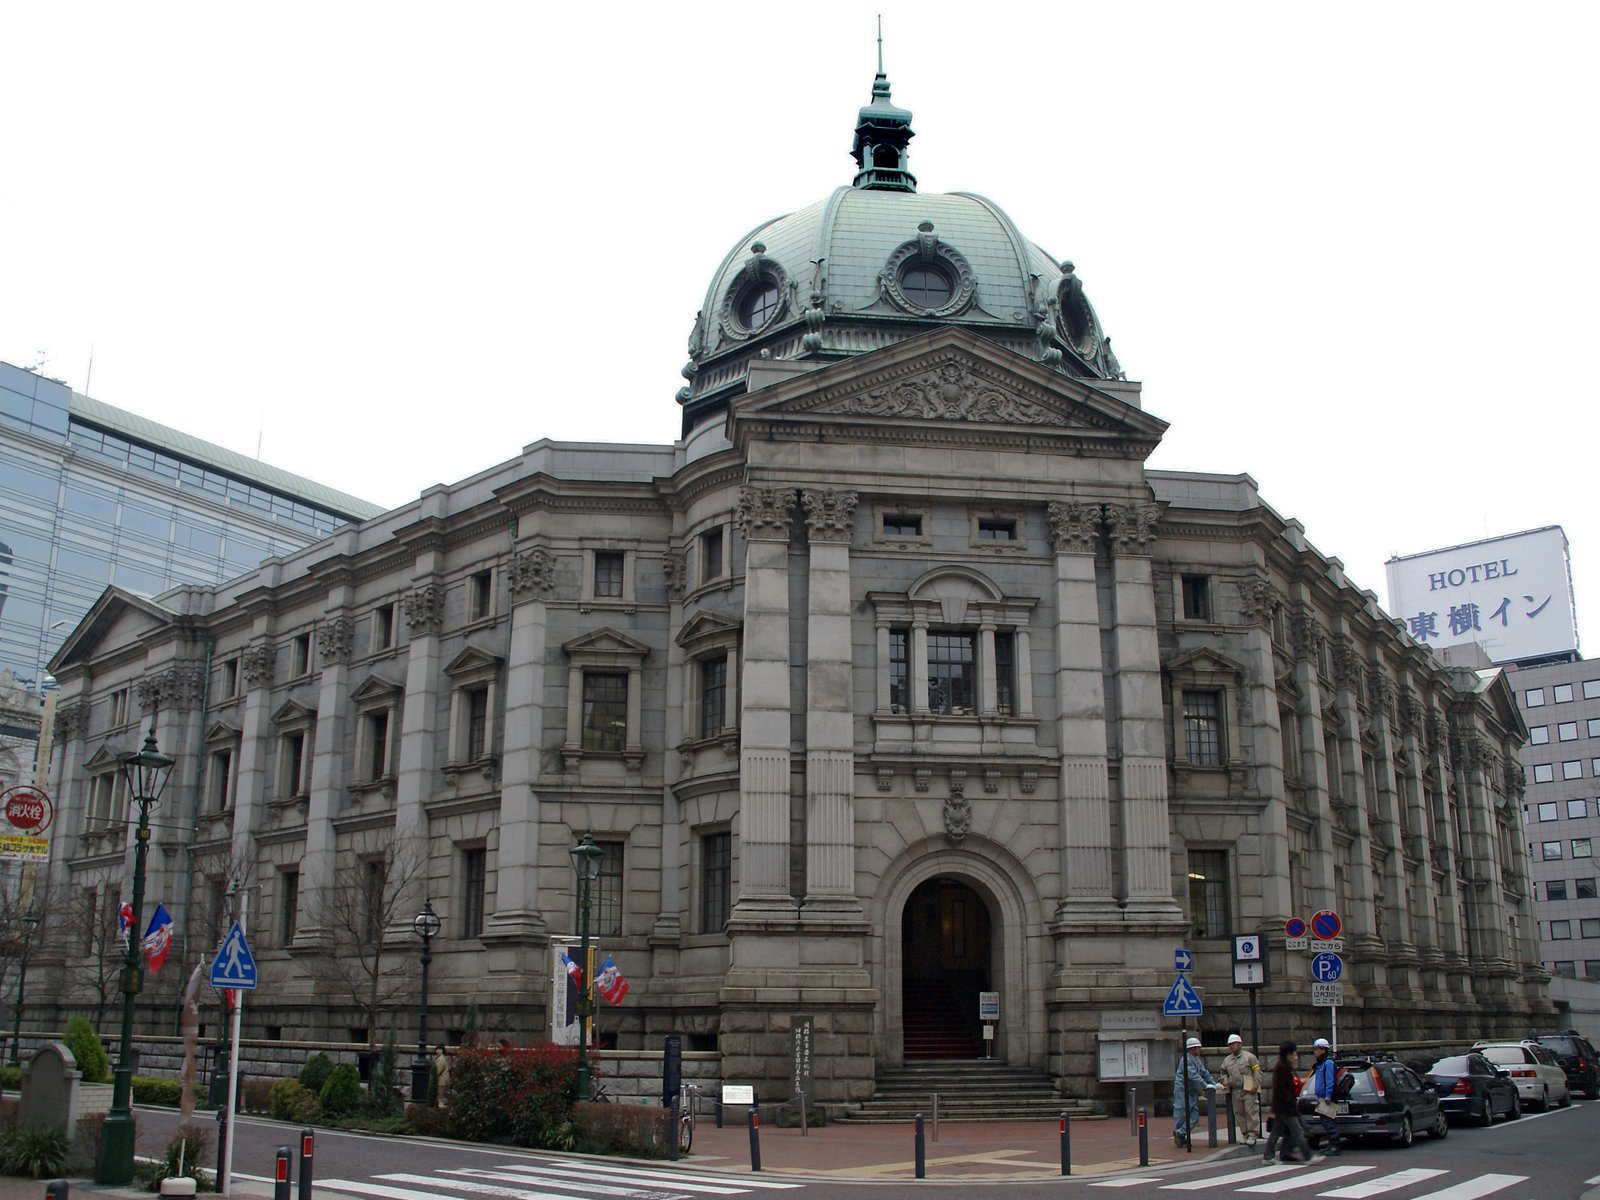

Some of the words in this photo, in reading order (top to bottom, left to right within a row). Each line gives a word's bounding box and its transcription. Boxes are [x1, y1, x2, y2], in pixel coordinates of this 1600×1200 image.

[1428, 559, 1518, 591] HOTEL
[1406, 594, 1552, 642] 東横イン
[8, 803, 42, 820] 消火栓
